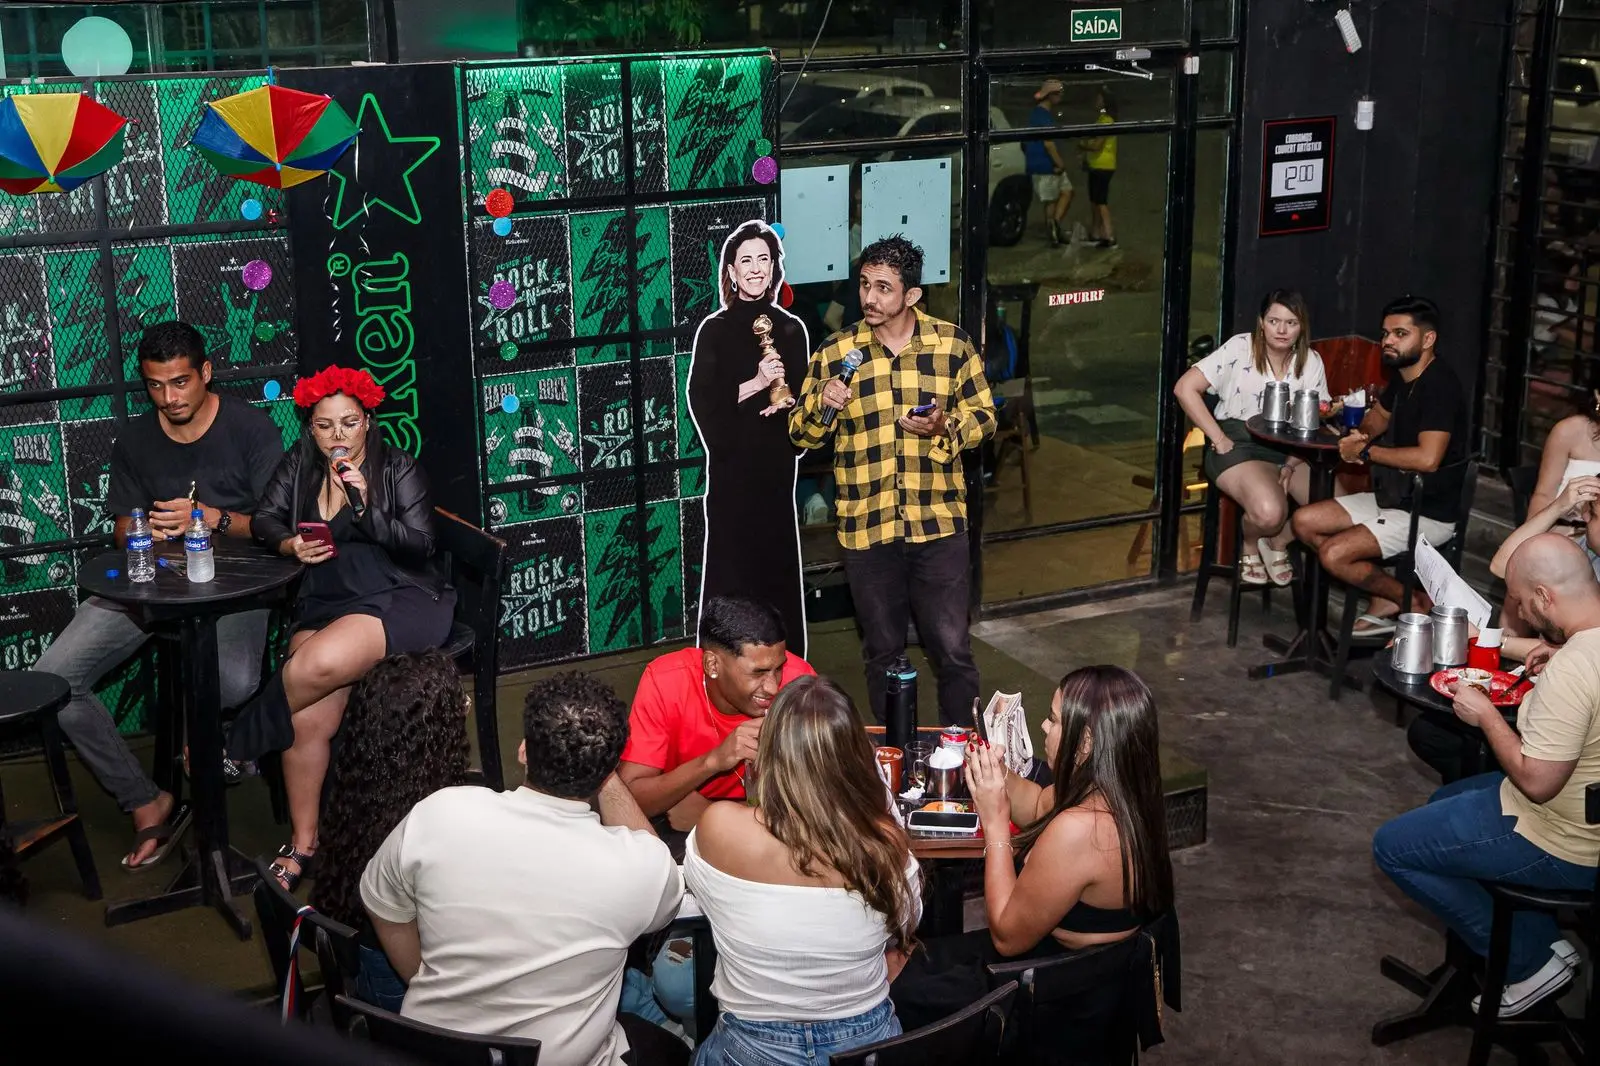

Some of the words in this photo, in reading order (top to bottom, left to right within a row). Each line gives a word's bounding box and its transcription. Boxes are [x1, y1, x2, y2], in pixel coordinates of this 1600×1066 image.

[1074, 16, 1118, 35] SAÍDA
[496, 303, 553, 343] ROLL
[603, 396, 656, 436] ROK
[510, 556, 564, 595] ROCK
[512, 599, 567, 639] ROLL
